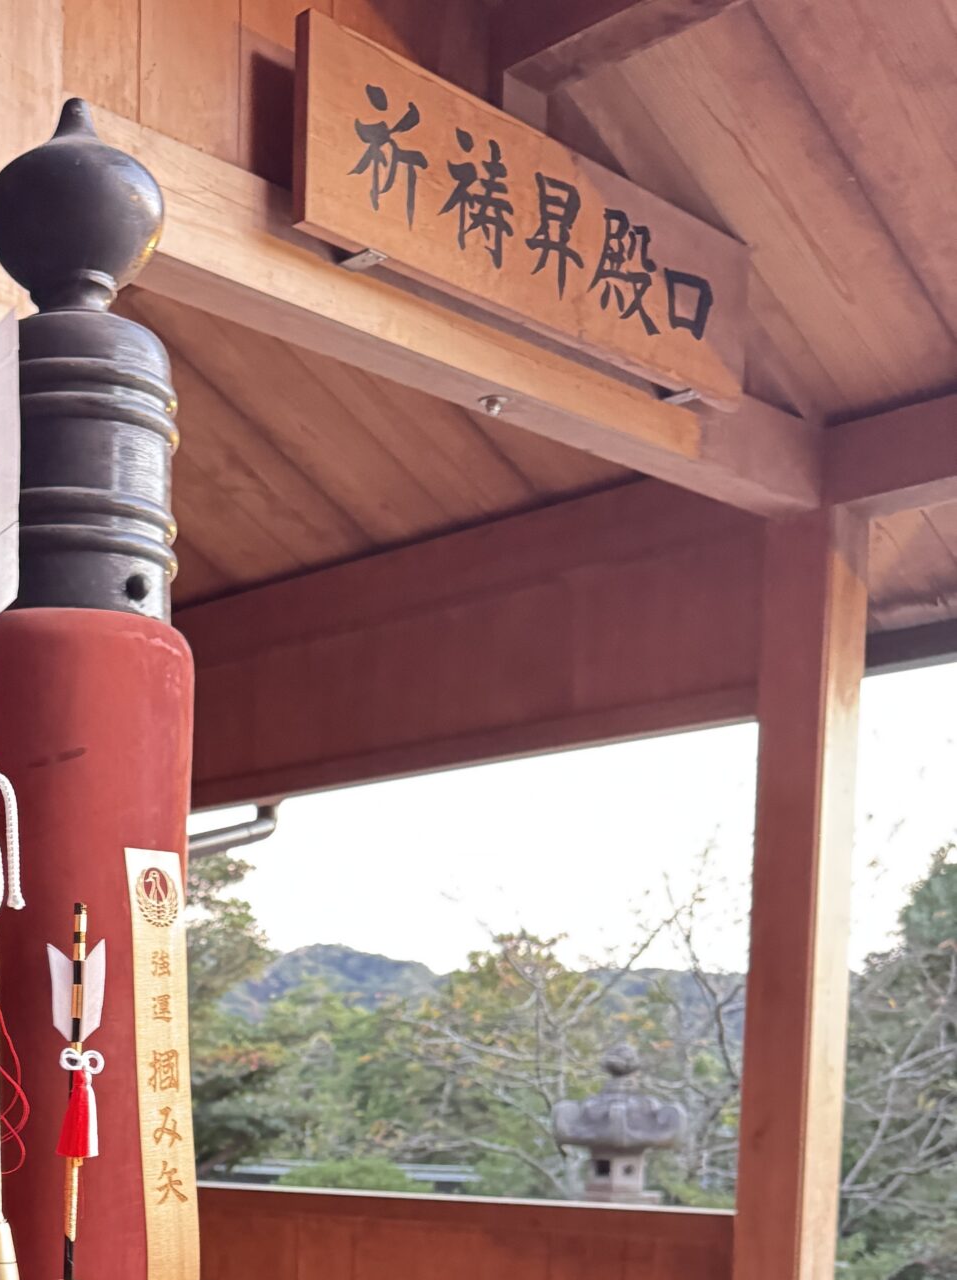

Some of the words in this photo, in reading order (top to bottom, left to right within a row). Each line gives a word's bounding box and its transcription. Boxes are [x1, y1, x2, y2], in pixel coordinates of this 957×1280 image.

[347, 84, 713, 340] 祈祷昇殿口
